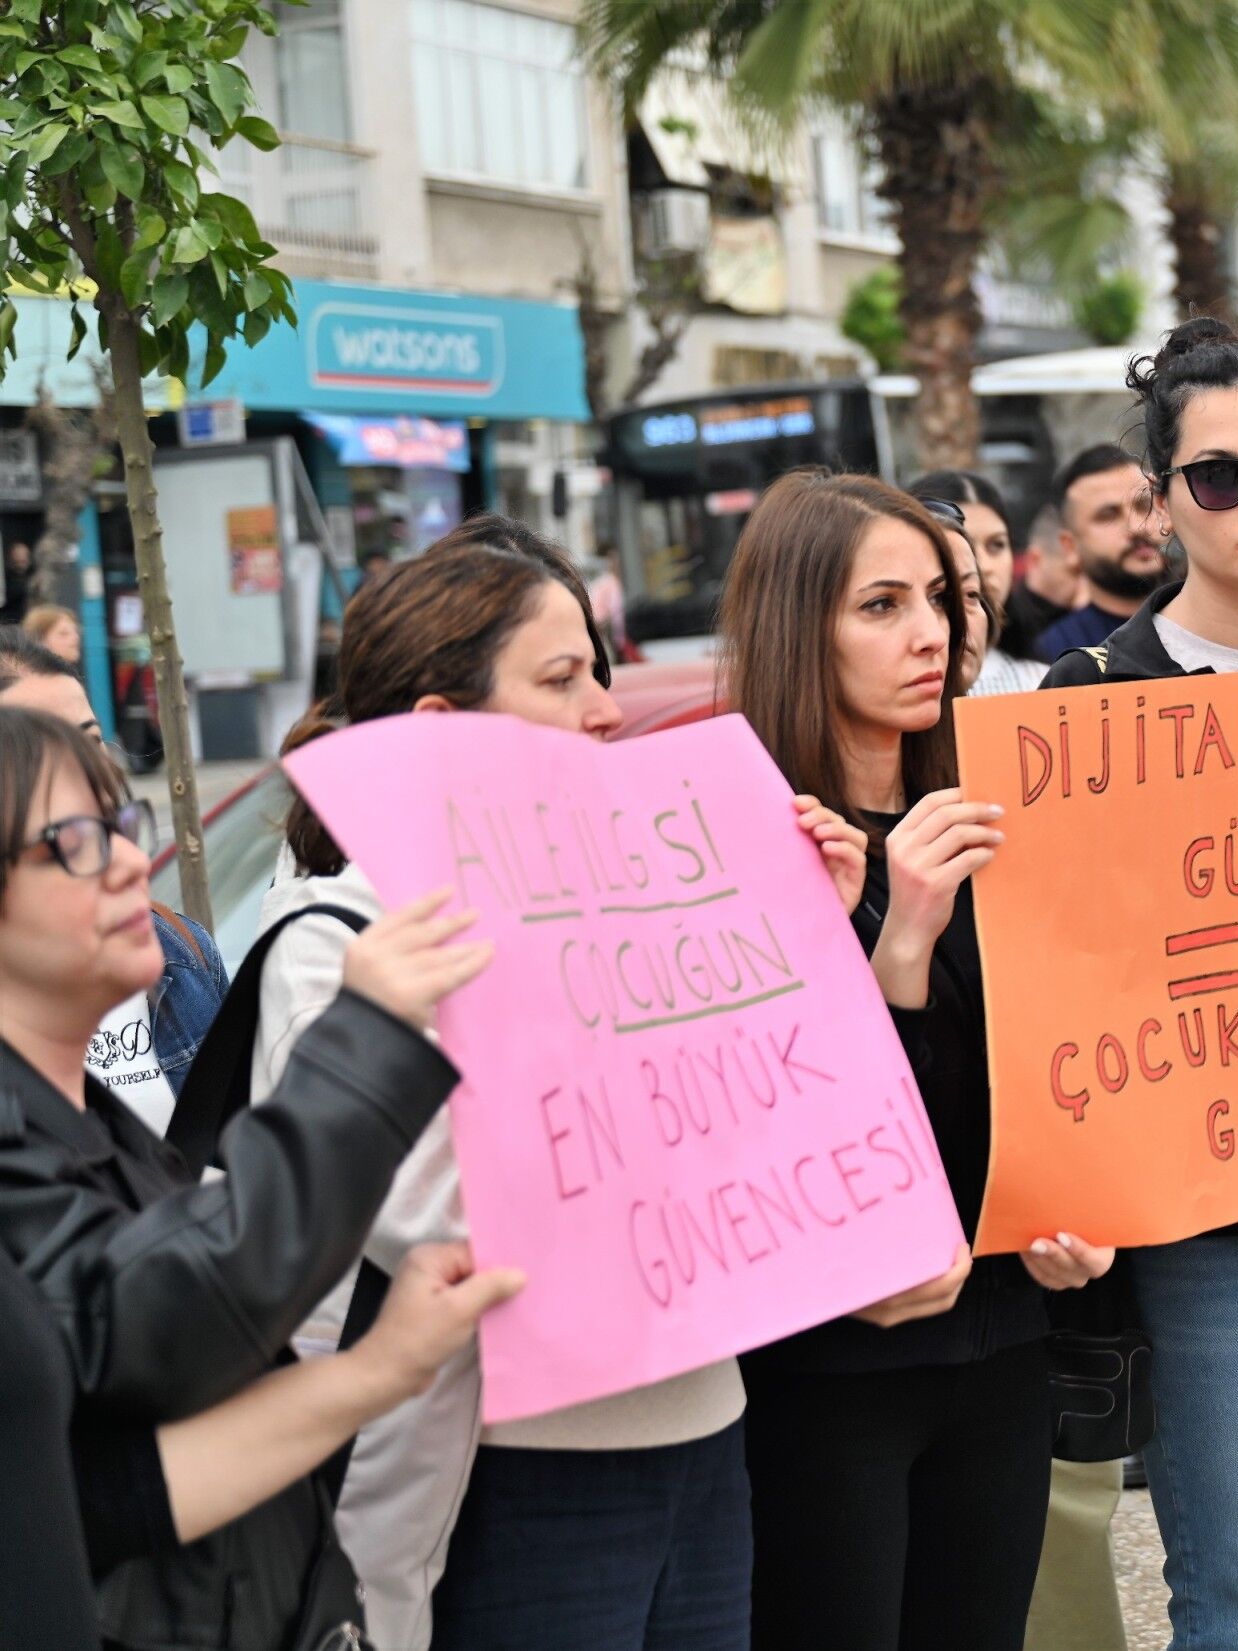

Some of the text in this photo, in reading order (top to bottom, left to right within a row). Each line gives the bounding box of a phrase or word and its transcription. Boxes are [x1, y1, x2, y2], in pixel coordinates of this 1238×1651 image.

[332, 323, 482, 374] watsons
[559, 911, 796, 1041] ÇOCUĞUN
[103, 1067, 161, 1088] YOURSELF
[538, 1021, 838, 1202] EN BÜYÜK
